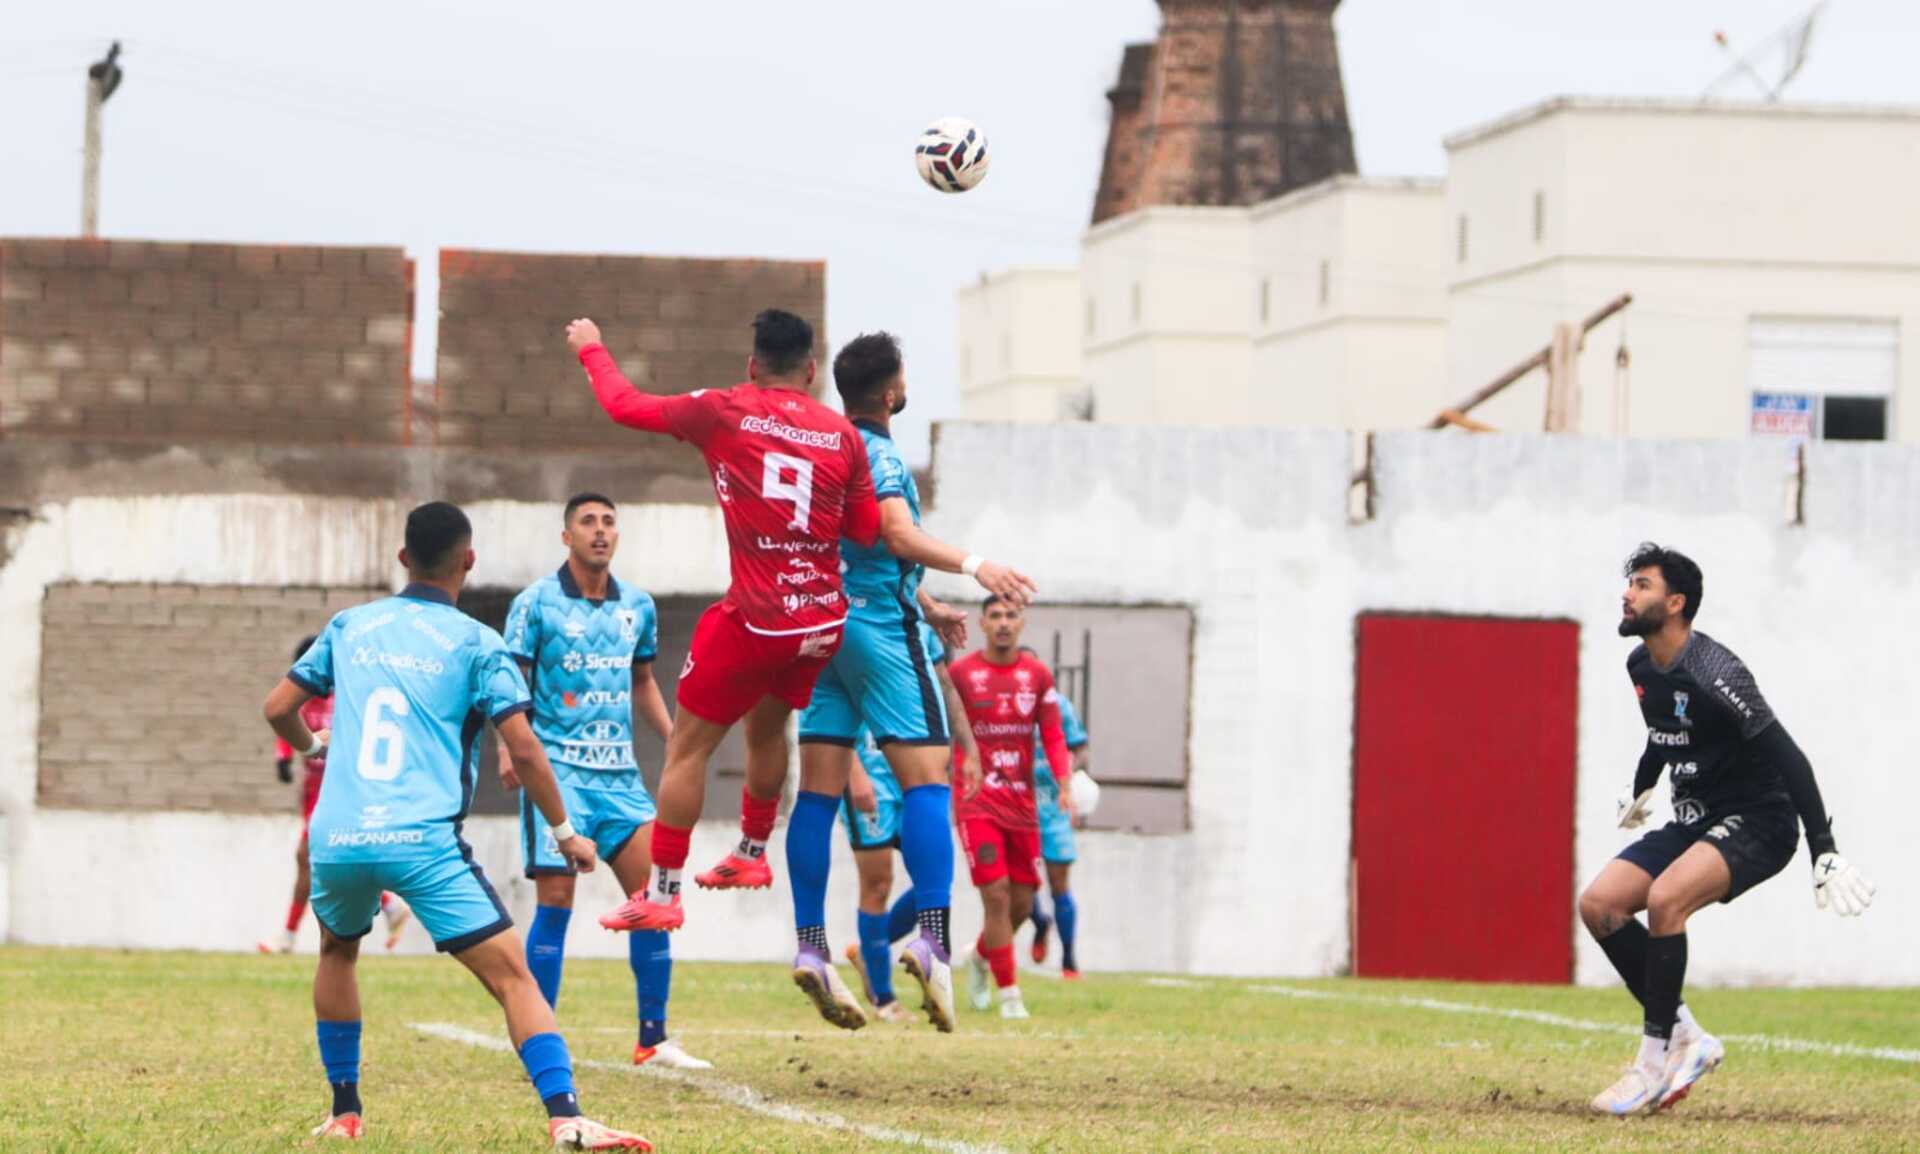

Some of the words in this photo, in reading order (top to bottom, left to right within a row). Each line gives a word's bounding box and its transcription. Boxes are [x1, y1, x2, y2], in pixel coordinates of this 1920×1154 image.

[762, 452, 813, 533] 9
[357, 687, 410, 781] 6
[582, 691, 631, 704] ATLA
